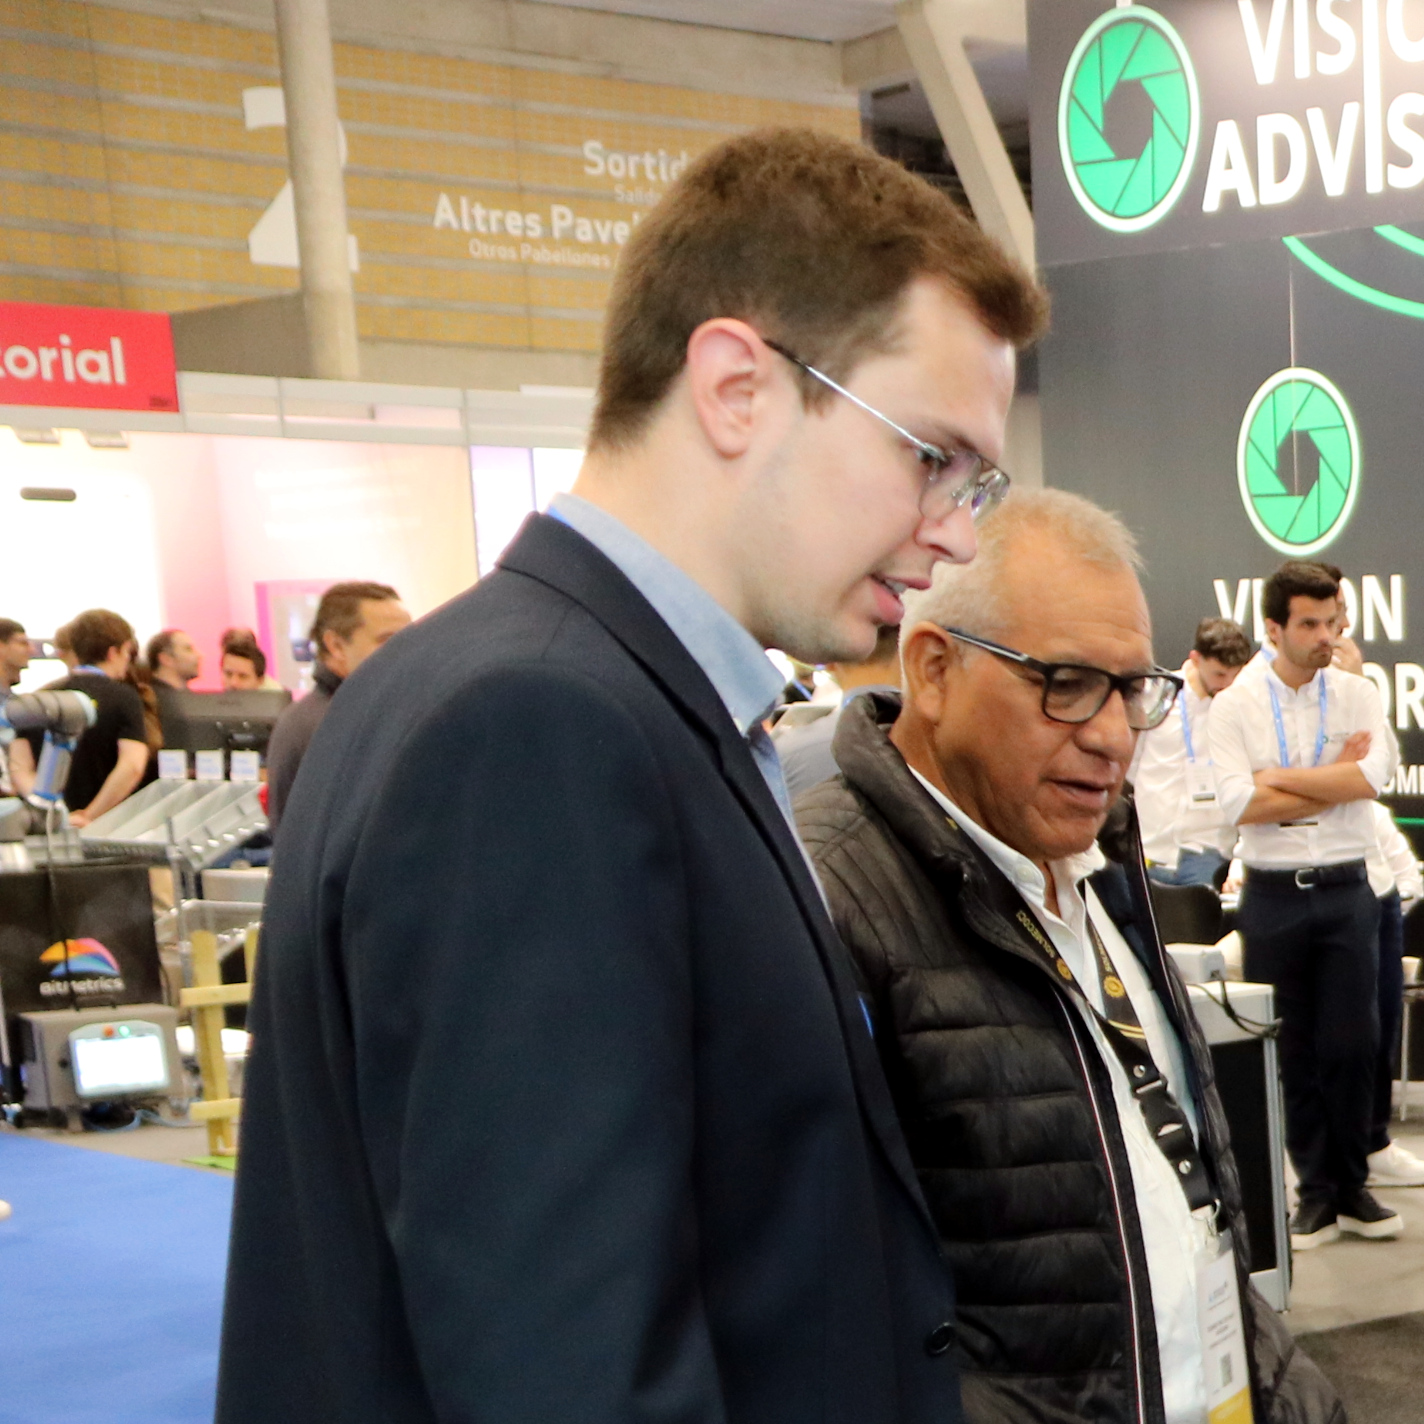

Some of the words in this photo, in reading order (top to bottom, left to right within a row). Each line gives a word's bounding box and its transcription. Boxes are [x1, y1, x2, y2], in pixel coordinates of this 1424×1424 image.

[583, 140, 690, 182] Sortid
[433, 192, 542, 238] Altres
[0, 333, 128, 387] orial
